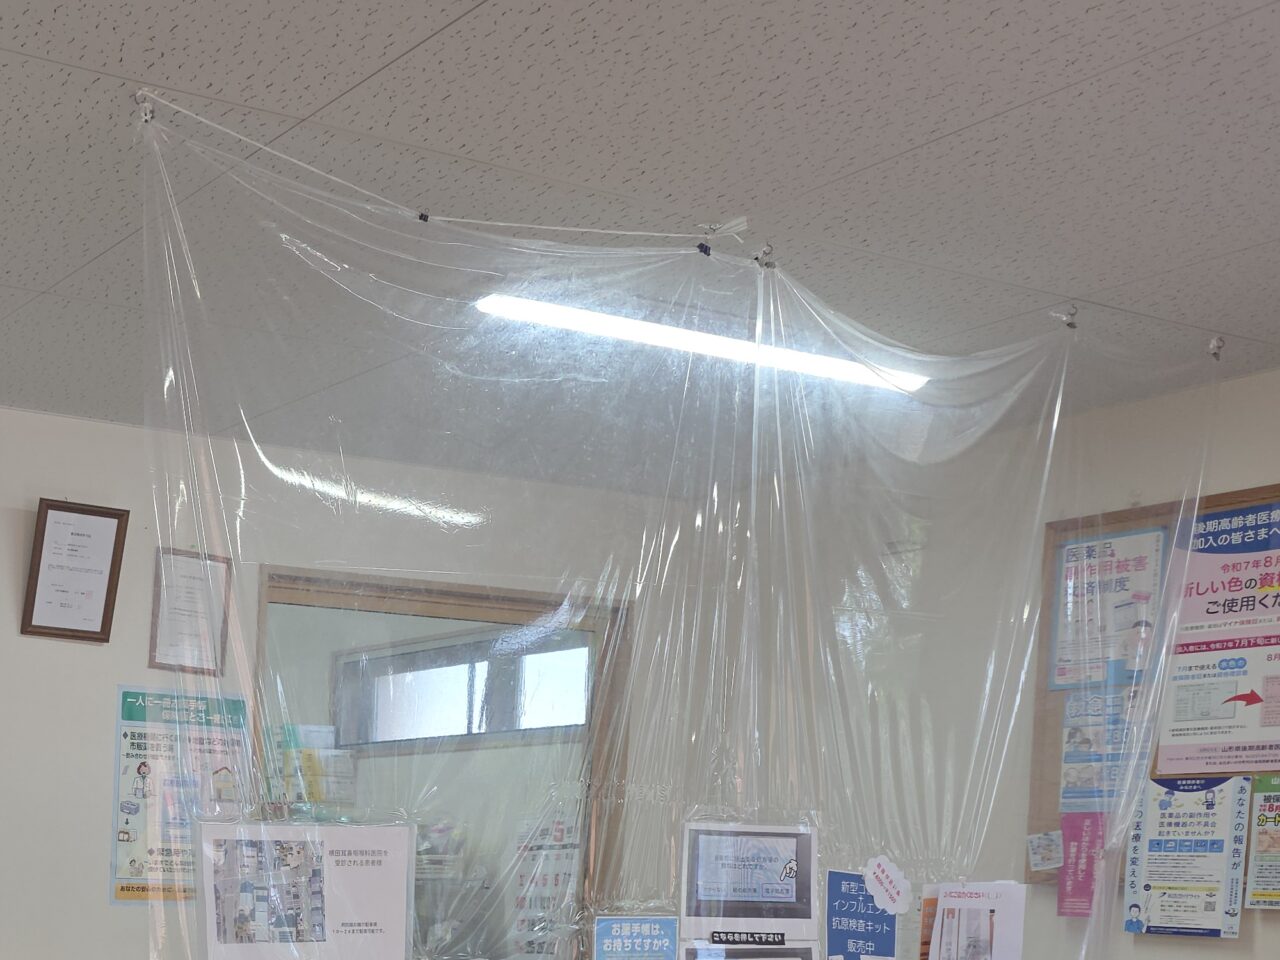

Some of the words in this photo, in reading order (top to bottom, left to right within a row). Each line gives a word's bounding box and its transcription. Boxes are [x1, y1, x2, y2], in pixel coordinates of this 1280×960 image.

[1231, 785, 1247, 871] あなたの報告が
[832, 917, 890, 934] 抗原検査キット
[847, 938, 875, 954] 販売中
